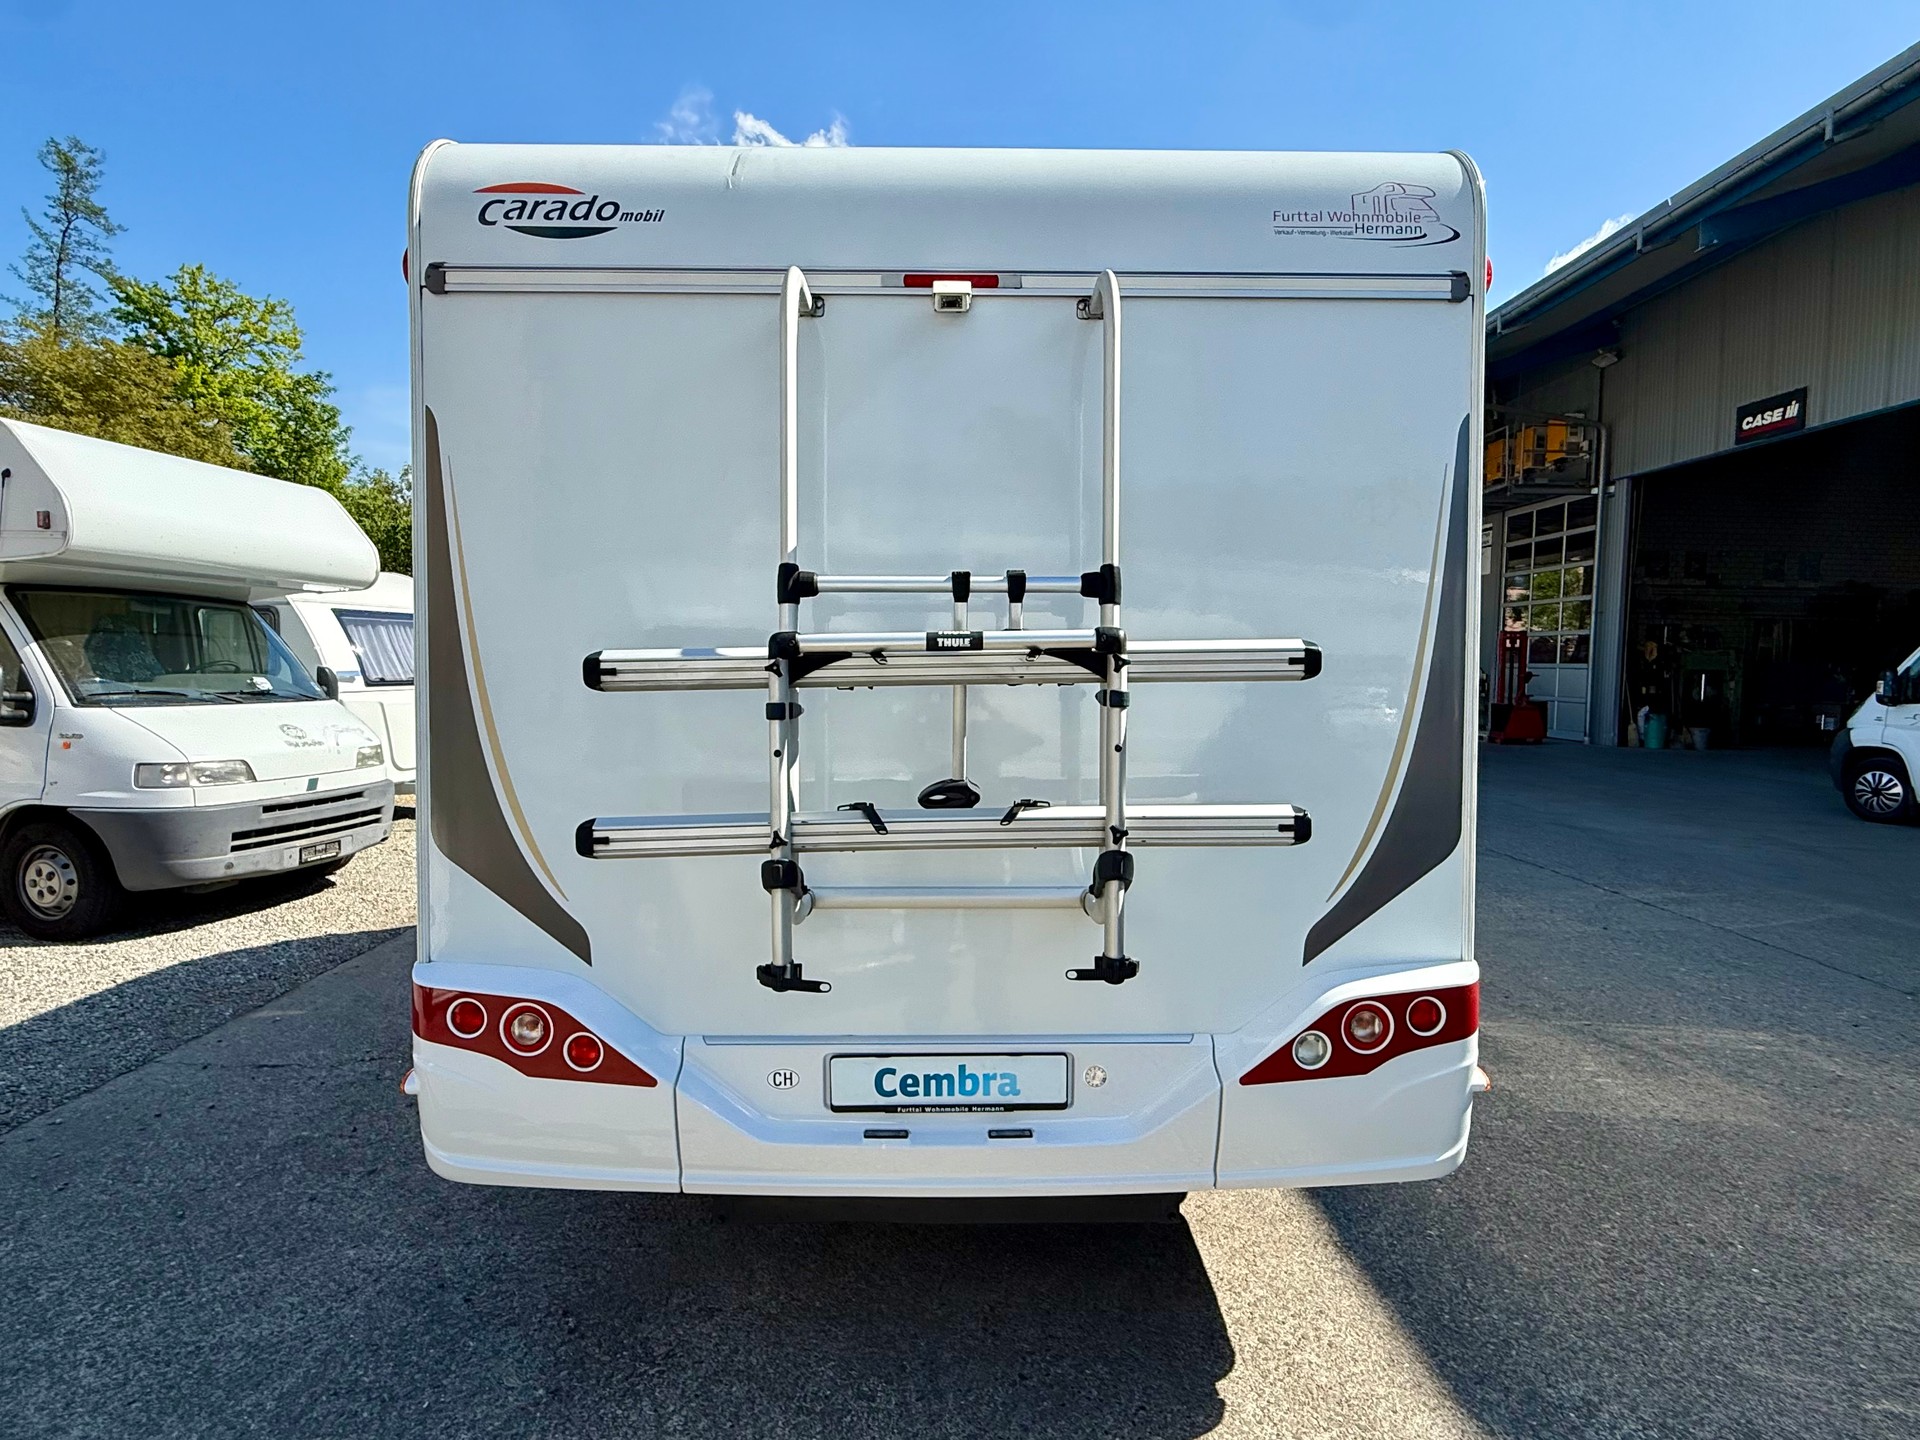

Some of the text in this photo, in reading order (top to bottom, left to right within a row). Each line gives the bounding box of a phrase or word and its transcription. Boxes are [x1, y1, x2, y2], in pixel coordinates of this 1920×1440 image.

[619, 209, 665, 223] mobil
[1273, 210, 1421, 223] Furttal Wohnmobile
[1354, 222, 1423, 235] Hermann
[1741, 407, 1784, 430] CASE
[936, 637, 971, 648] THULE
[772, 1071, 795, 1087] CH
[873, 1063, 1021, 1098] Cembra
